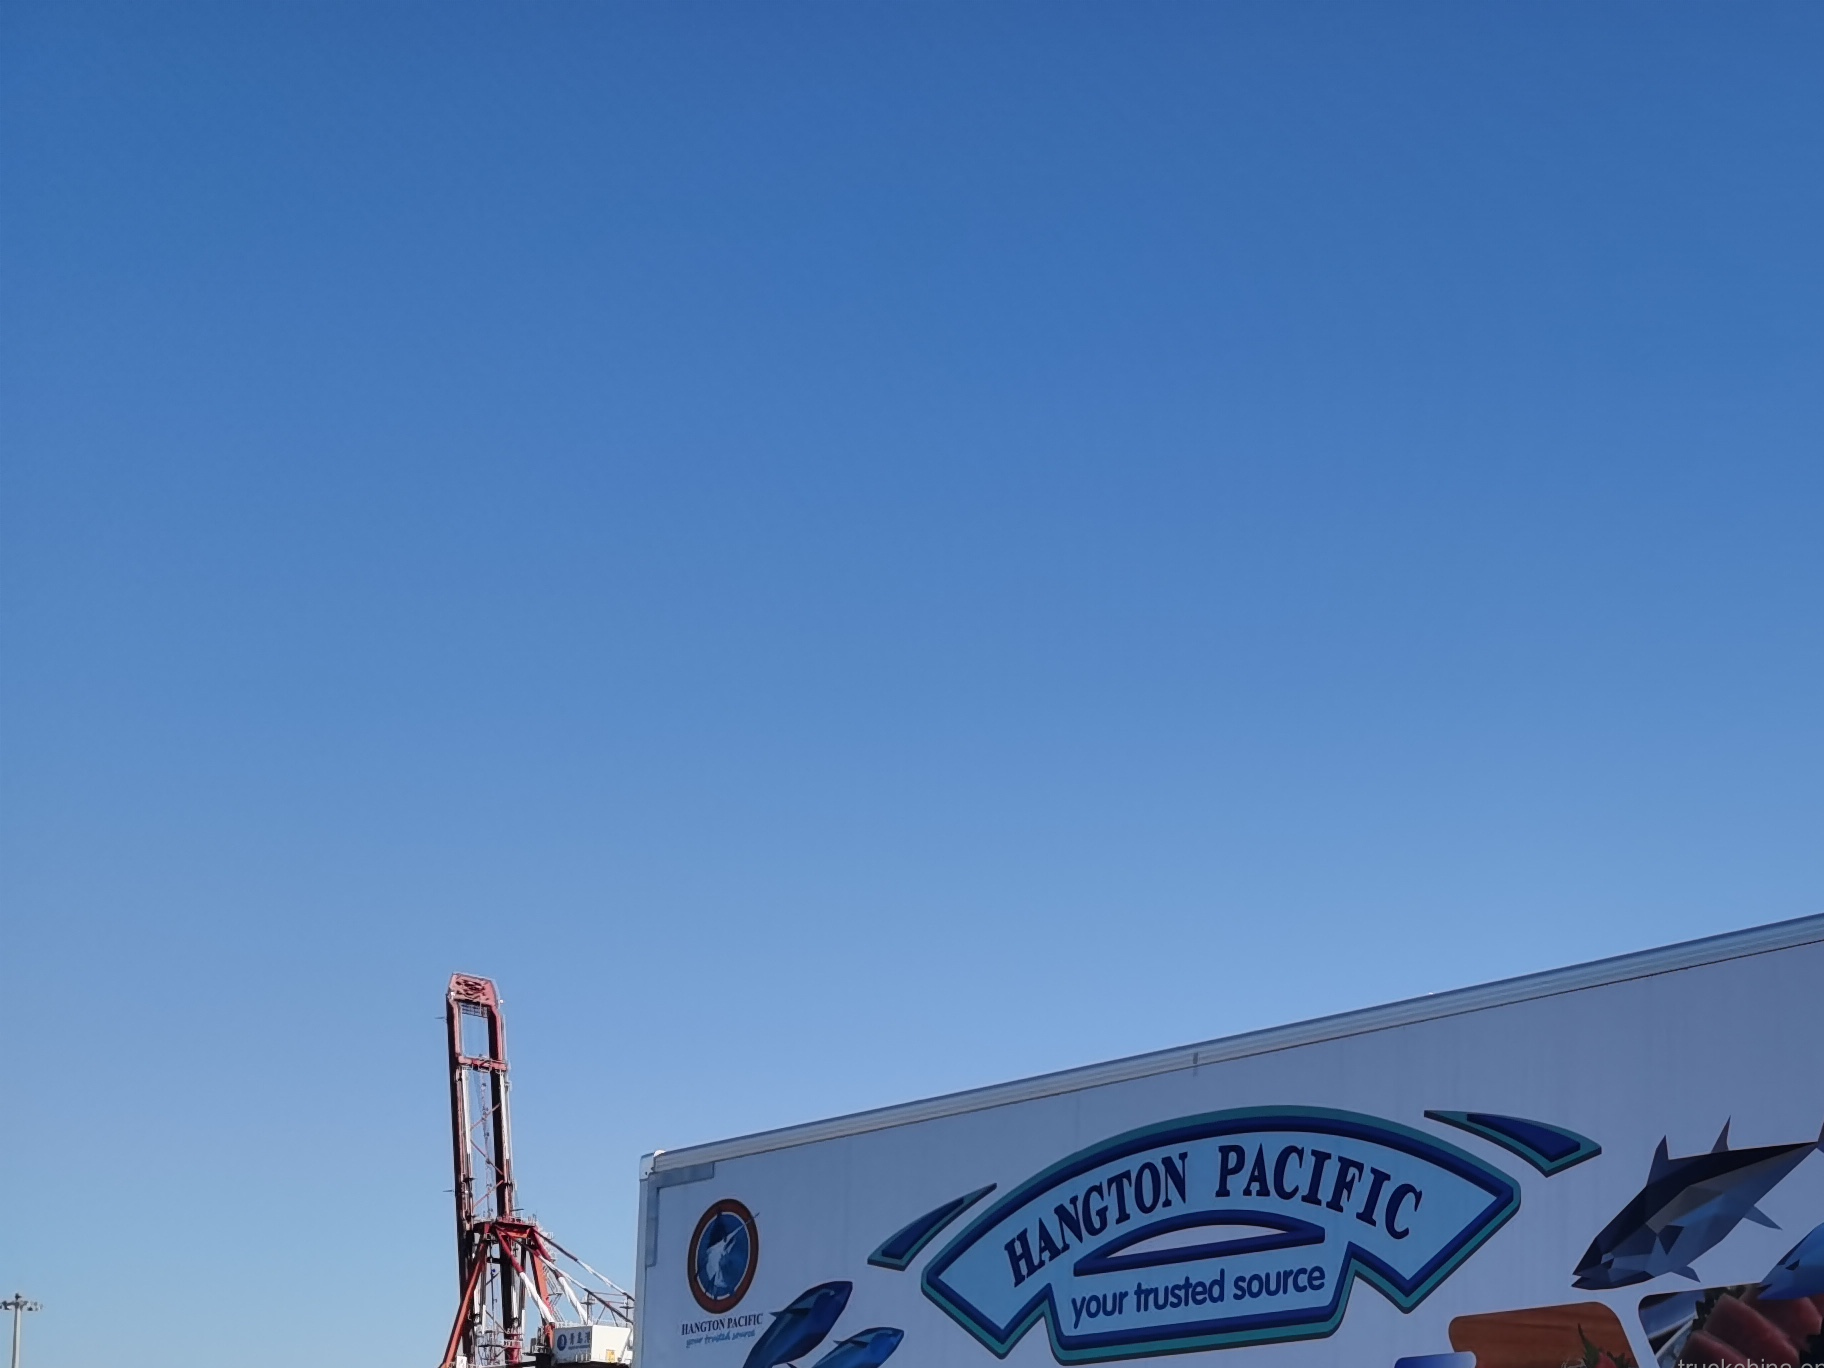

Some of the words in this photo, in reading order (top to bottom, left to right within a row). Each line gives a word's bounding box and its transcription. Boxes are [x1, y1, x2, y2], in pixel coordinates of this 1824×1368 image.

[1004, 1151, 1188, 1287] HANGTON
[1216, 1142, 1422, 1239] PACIFIC
[1072, 1284, 1127, 1328] your
[1135, 1269, 1225, 1312] trusted
[1233, 1265, 1326, 1301] source
[681, 1318, 726, 1336] HANGTON
[727, 1312, 764, 1329] PACIFIC
[686, 1337, 703, 1348] your
[705, 1331, 730, 1344] trusted
